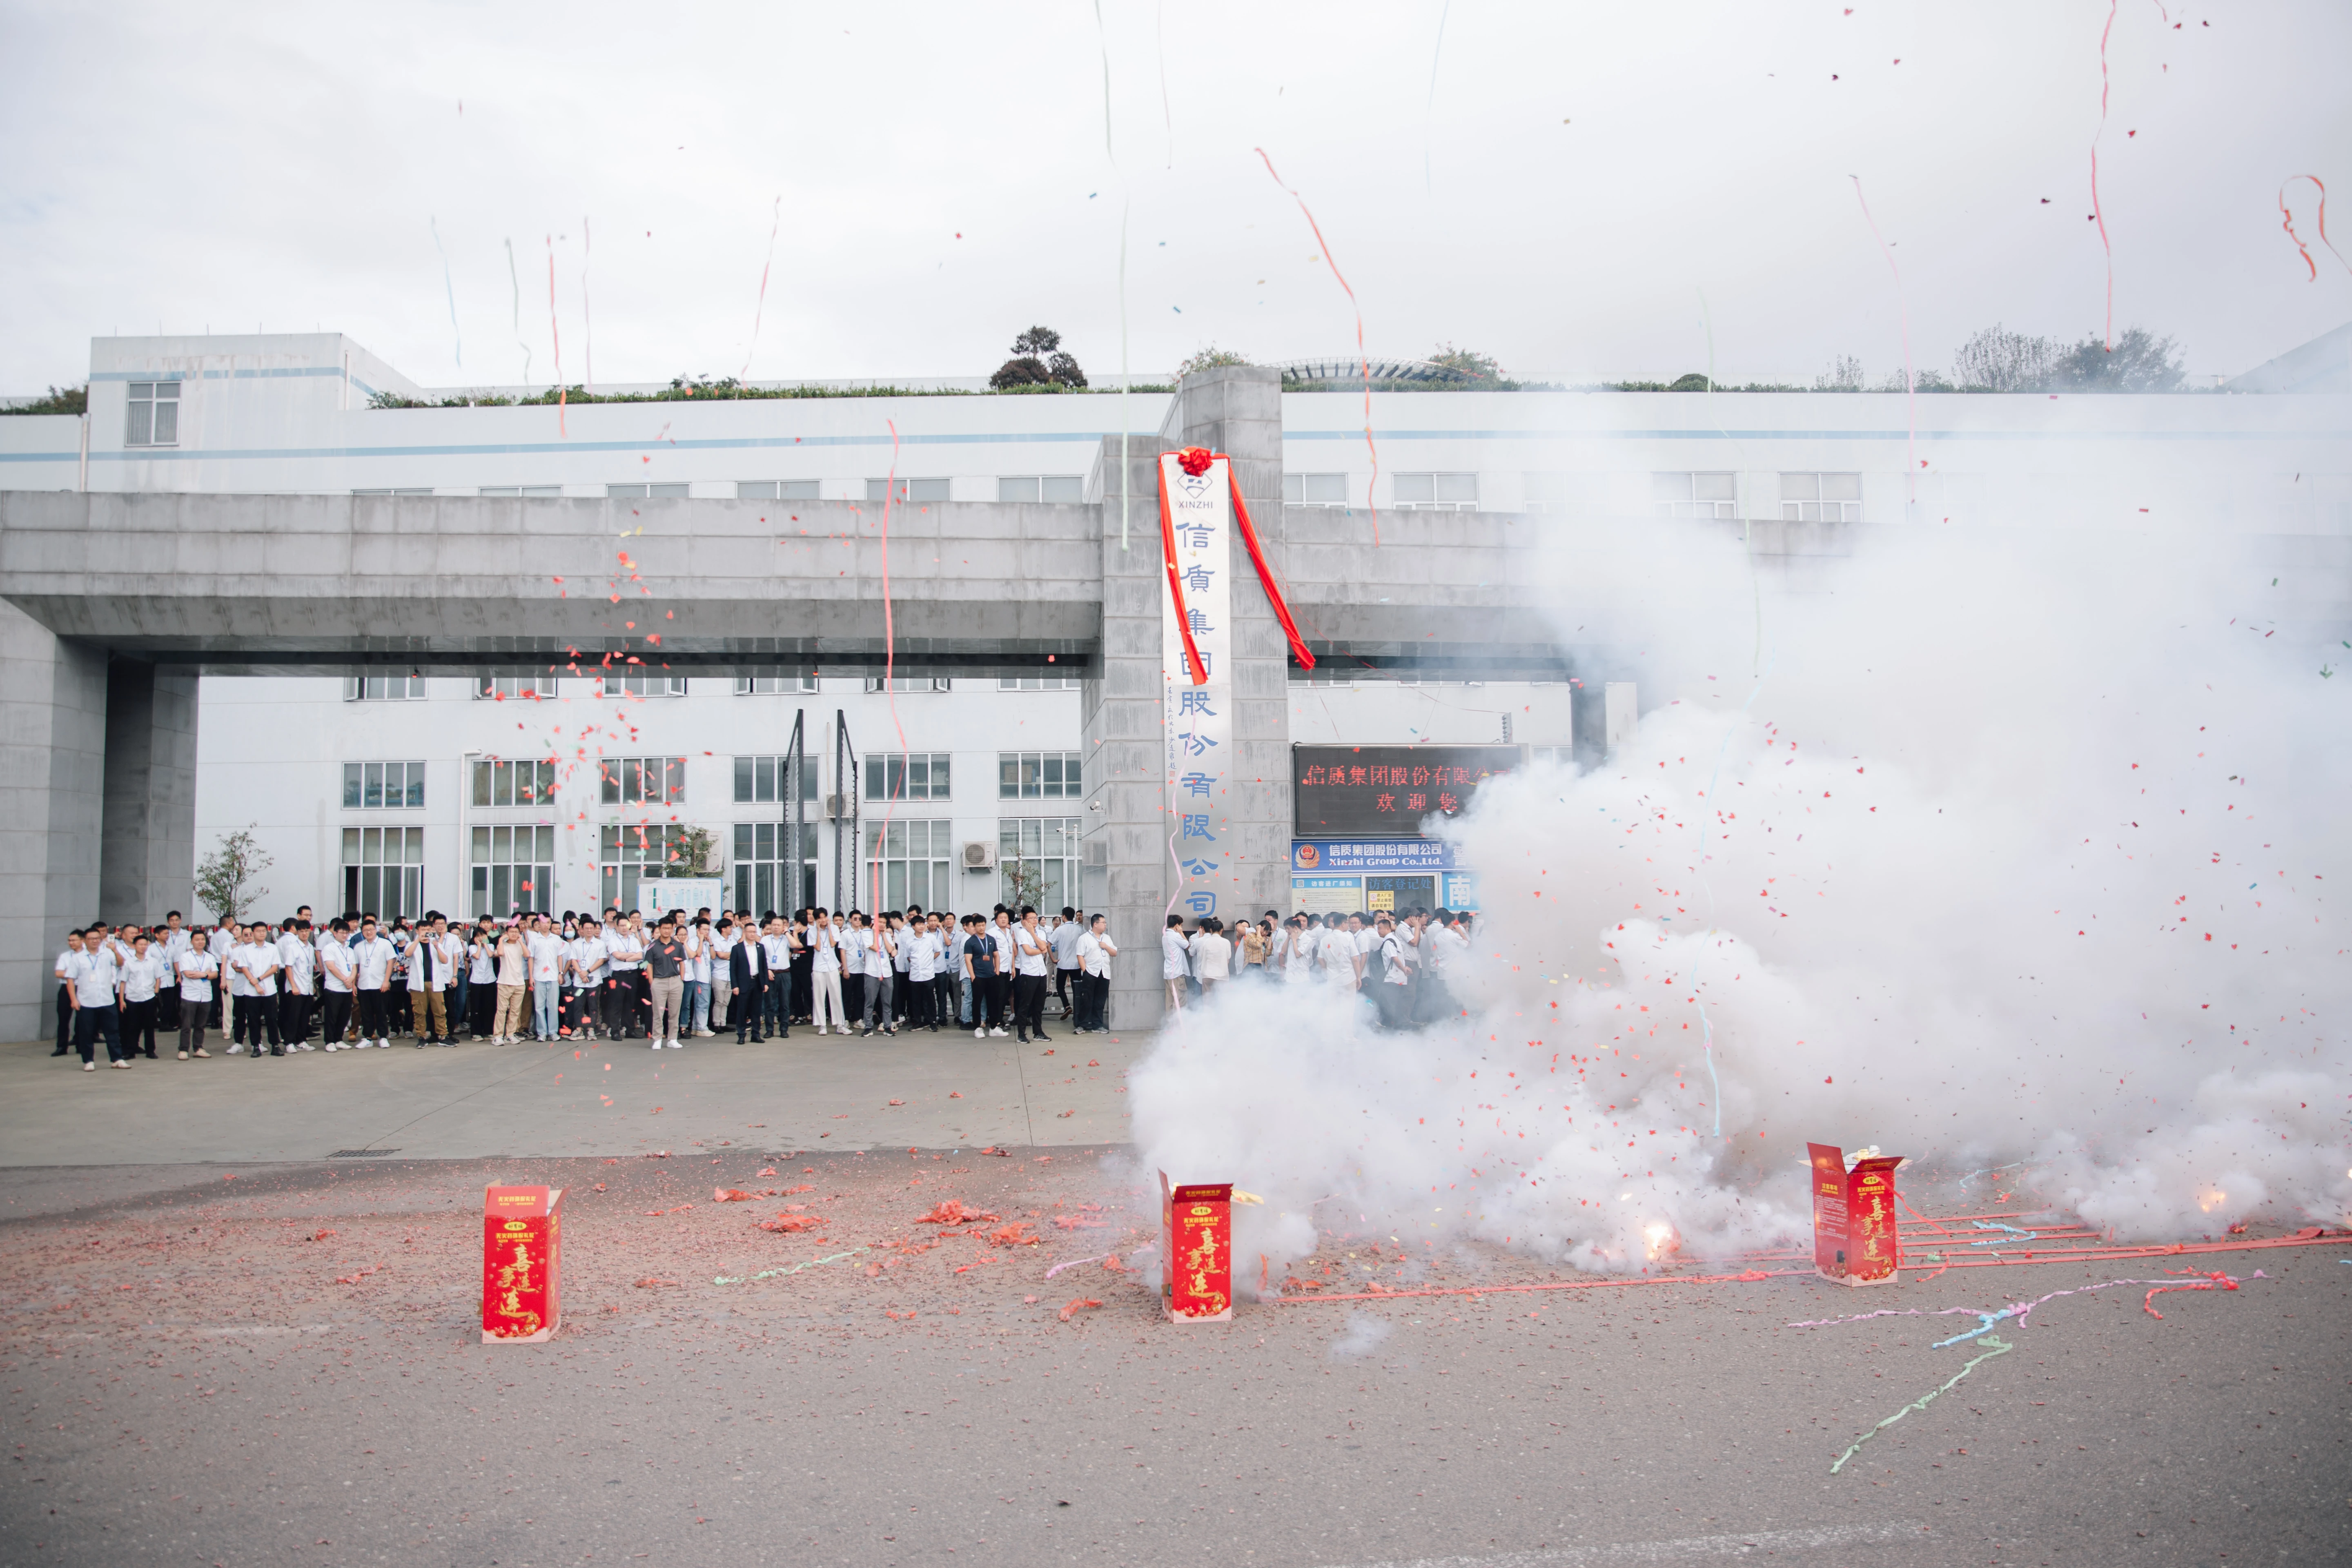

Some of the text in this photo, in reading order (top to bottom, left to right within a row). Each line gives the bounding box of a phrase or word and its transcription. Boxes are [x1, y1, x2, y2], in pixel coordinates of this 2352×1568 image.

[1376, 792, 1457, 812] 欢迎您
[1329, 844, 1442, 856] 信质集团股份有限公司
[1402, 858, 1443, 866] Co.,Ltd.
[1369, 878, 1431, 890] 访客登记处
[1448, 875, 1471, 906] 南
